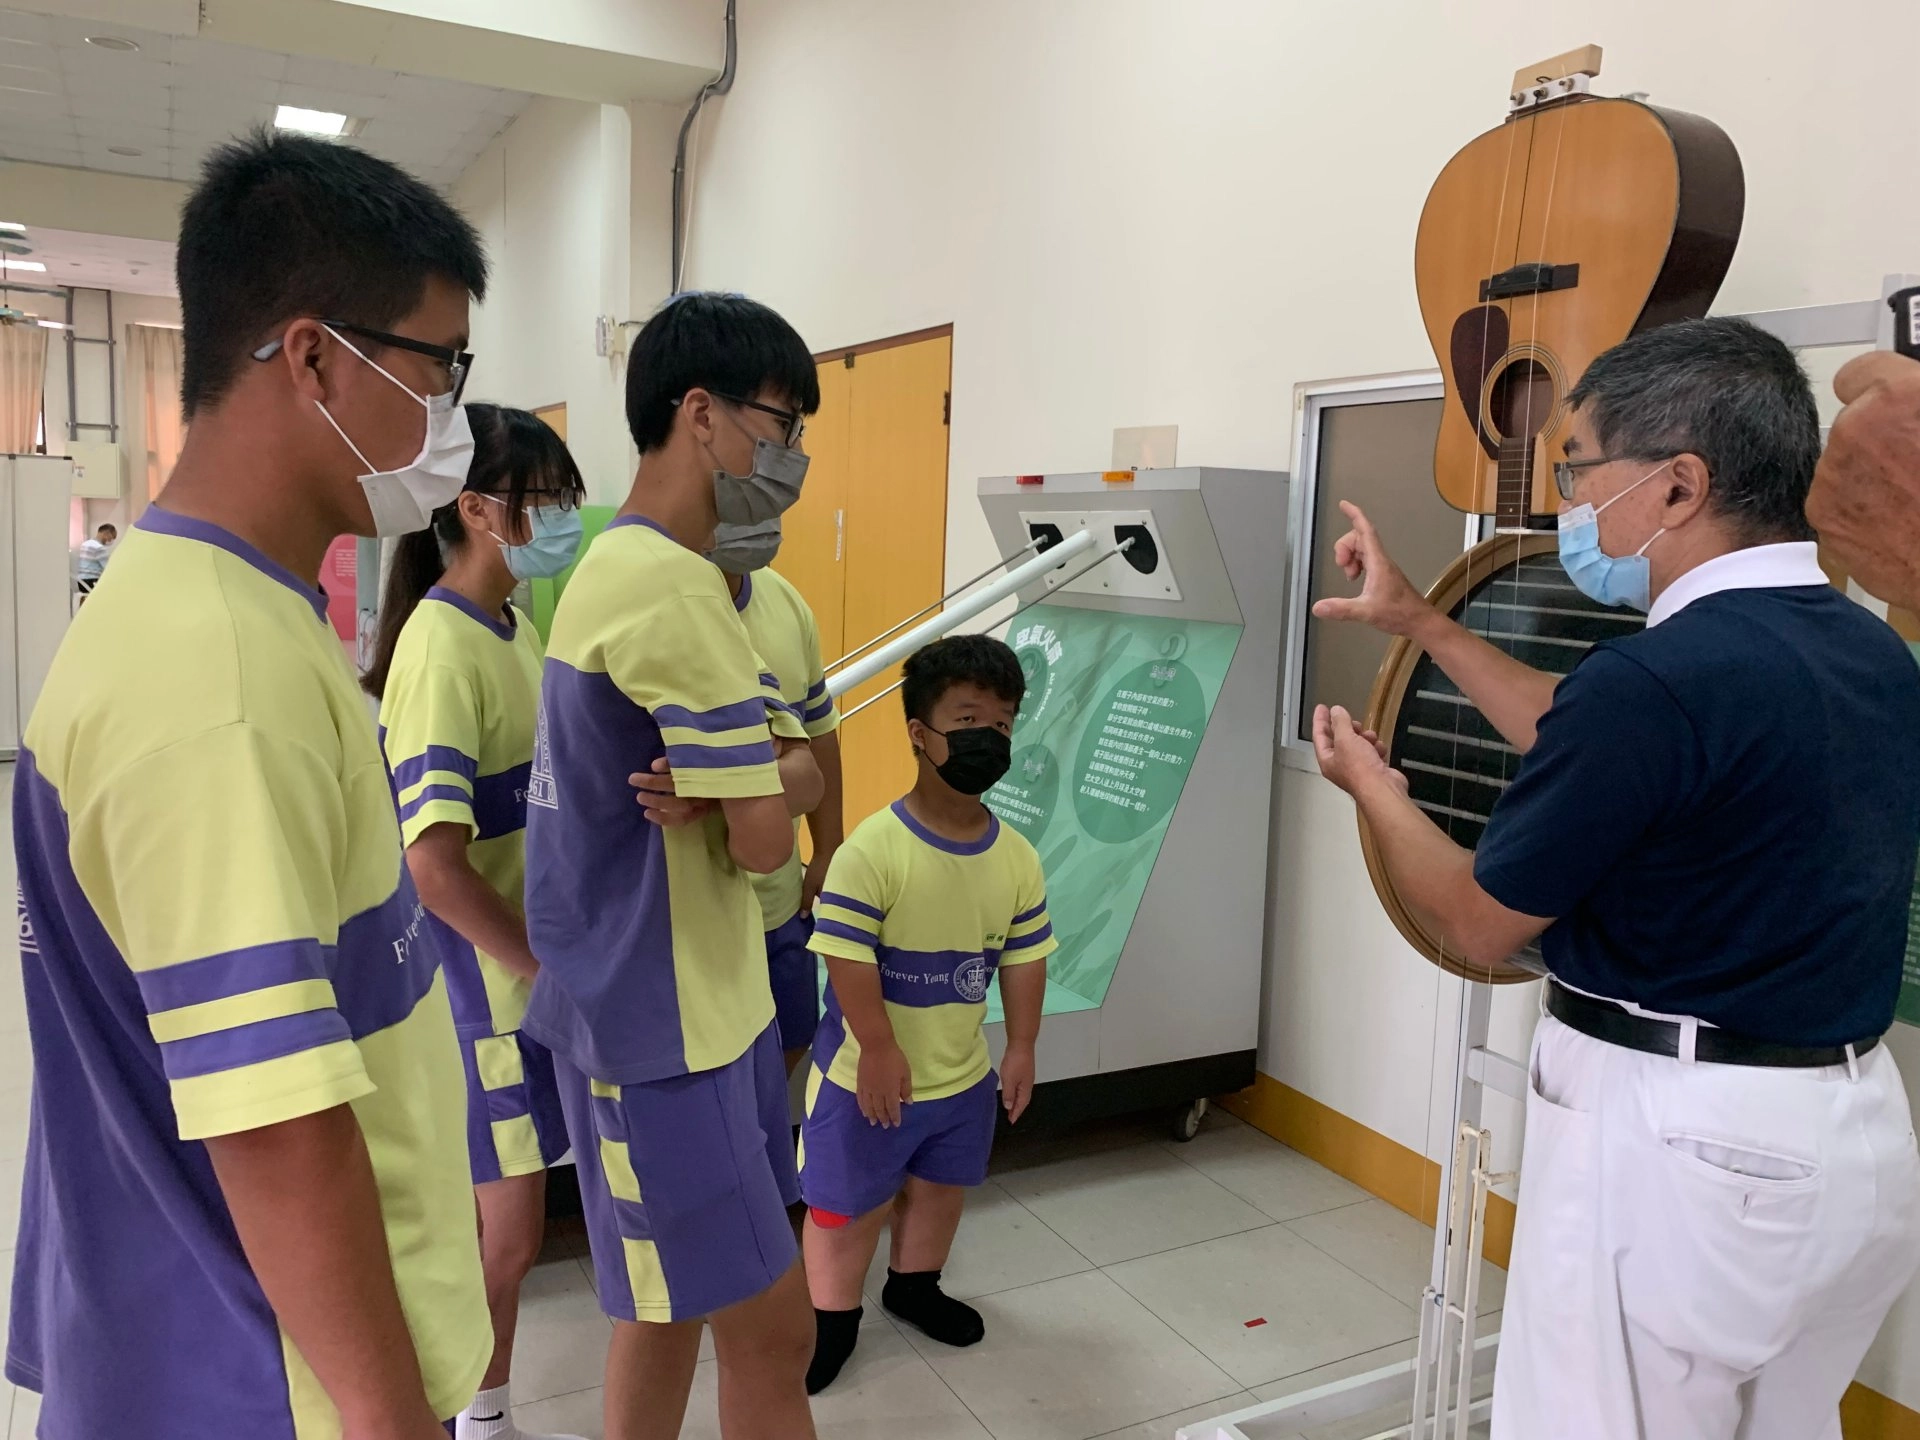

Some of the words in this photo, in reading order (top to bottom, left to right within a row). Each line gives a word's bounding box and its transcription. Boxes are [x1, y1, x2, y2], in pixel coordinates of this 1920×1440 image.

[1015, 624, 1063, 666] 空氣火箭
[880, 962, 919, 983] Forever
[923, 972, 950, 985] Young
